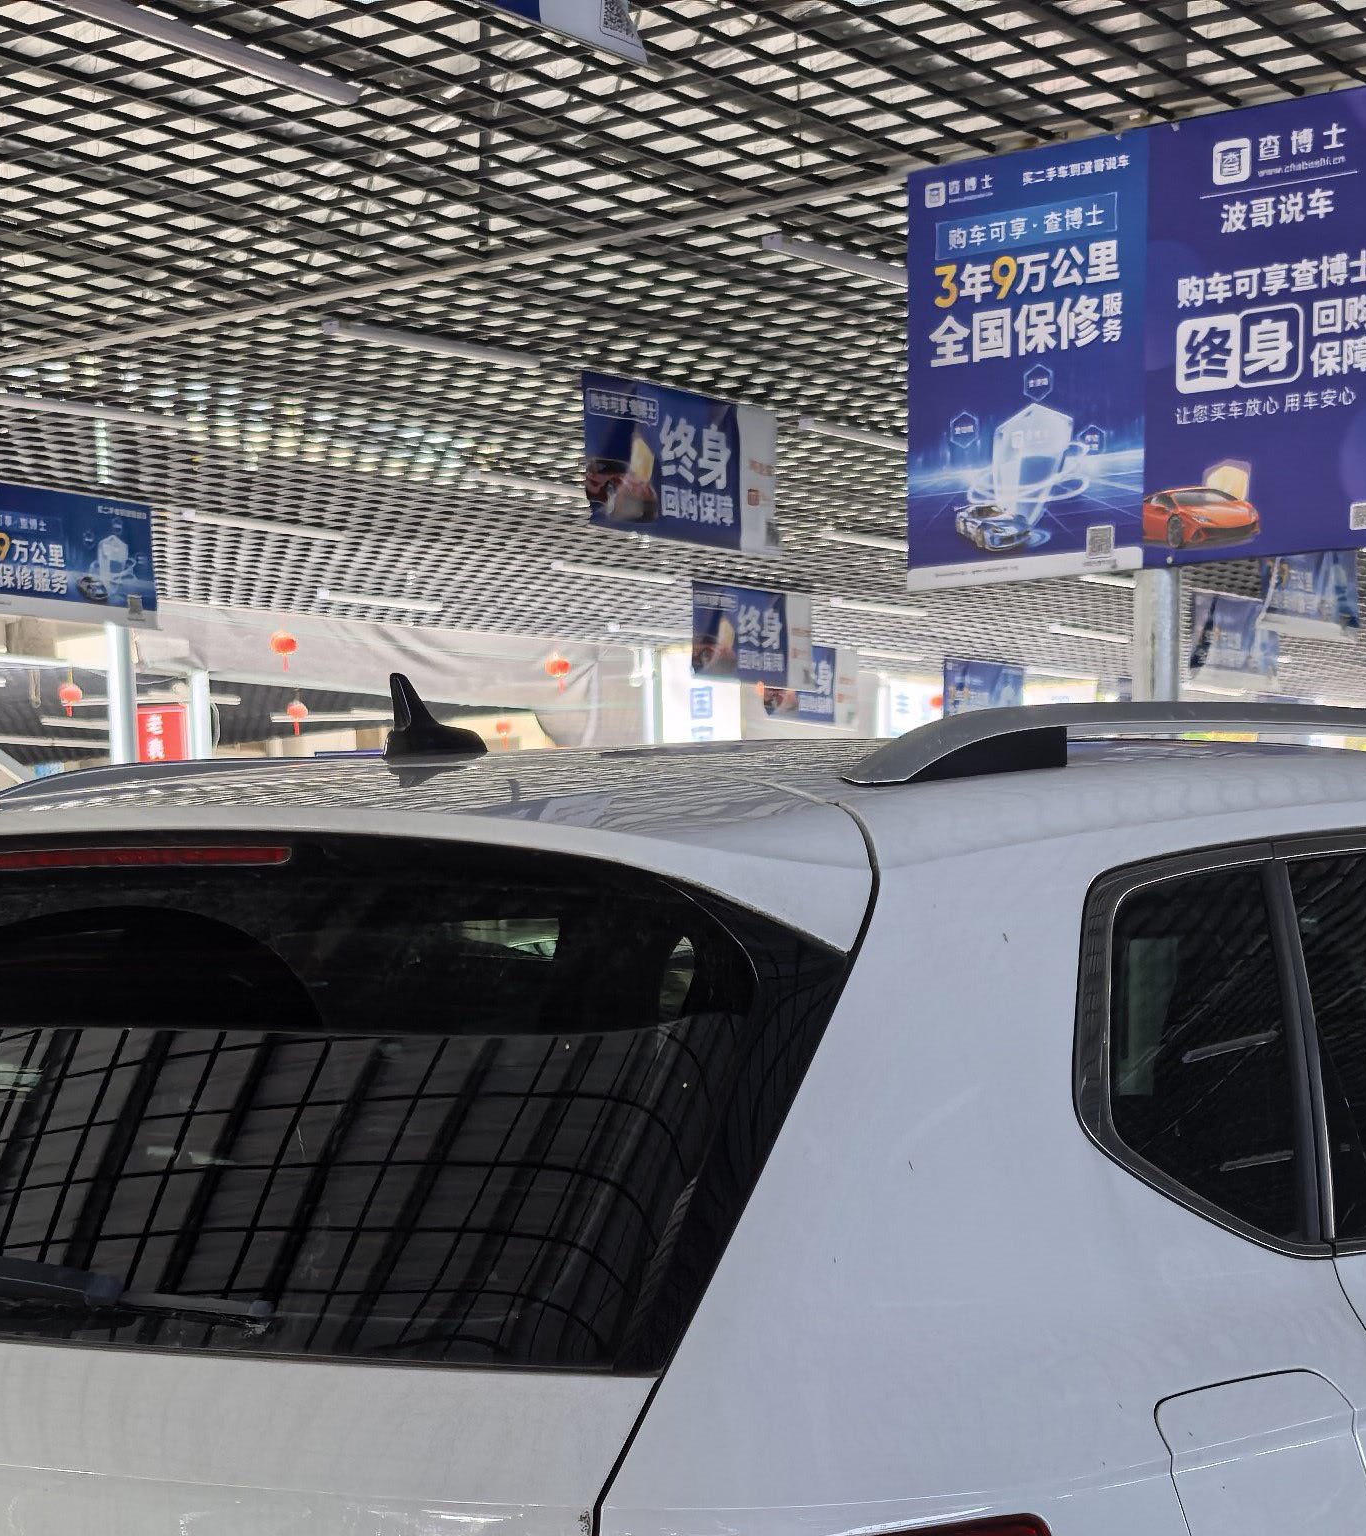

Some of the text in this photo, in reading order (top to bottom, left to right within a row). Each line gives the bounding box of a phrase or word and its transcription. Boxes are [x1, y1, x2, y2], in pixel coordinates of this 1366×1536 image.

[1258, 122, 1347, 162] 查博士
[948, 202, 1105, 250] 购车可享·查博士
[1221, 188, 1334, 233] 波哥说车
[934, 240, 1121, 308] 3年9万公里
[1183, 318, 1295, 382] 终身
[1176, 386, 1357, 425] 让您买车放心 用车安心
[660, 415, 732, 490] 终身
[661, 485, 734, 527] 回购保障
[738, 605, 783, 650] 终身
[812, 659, 834, 696] 身
